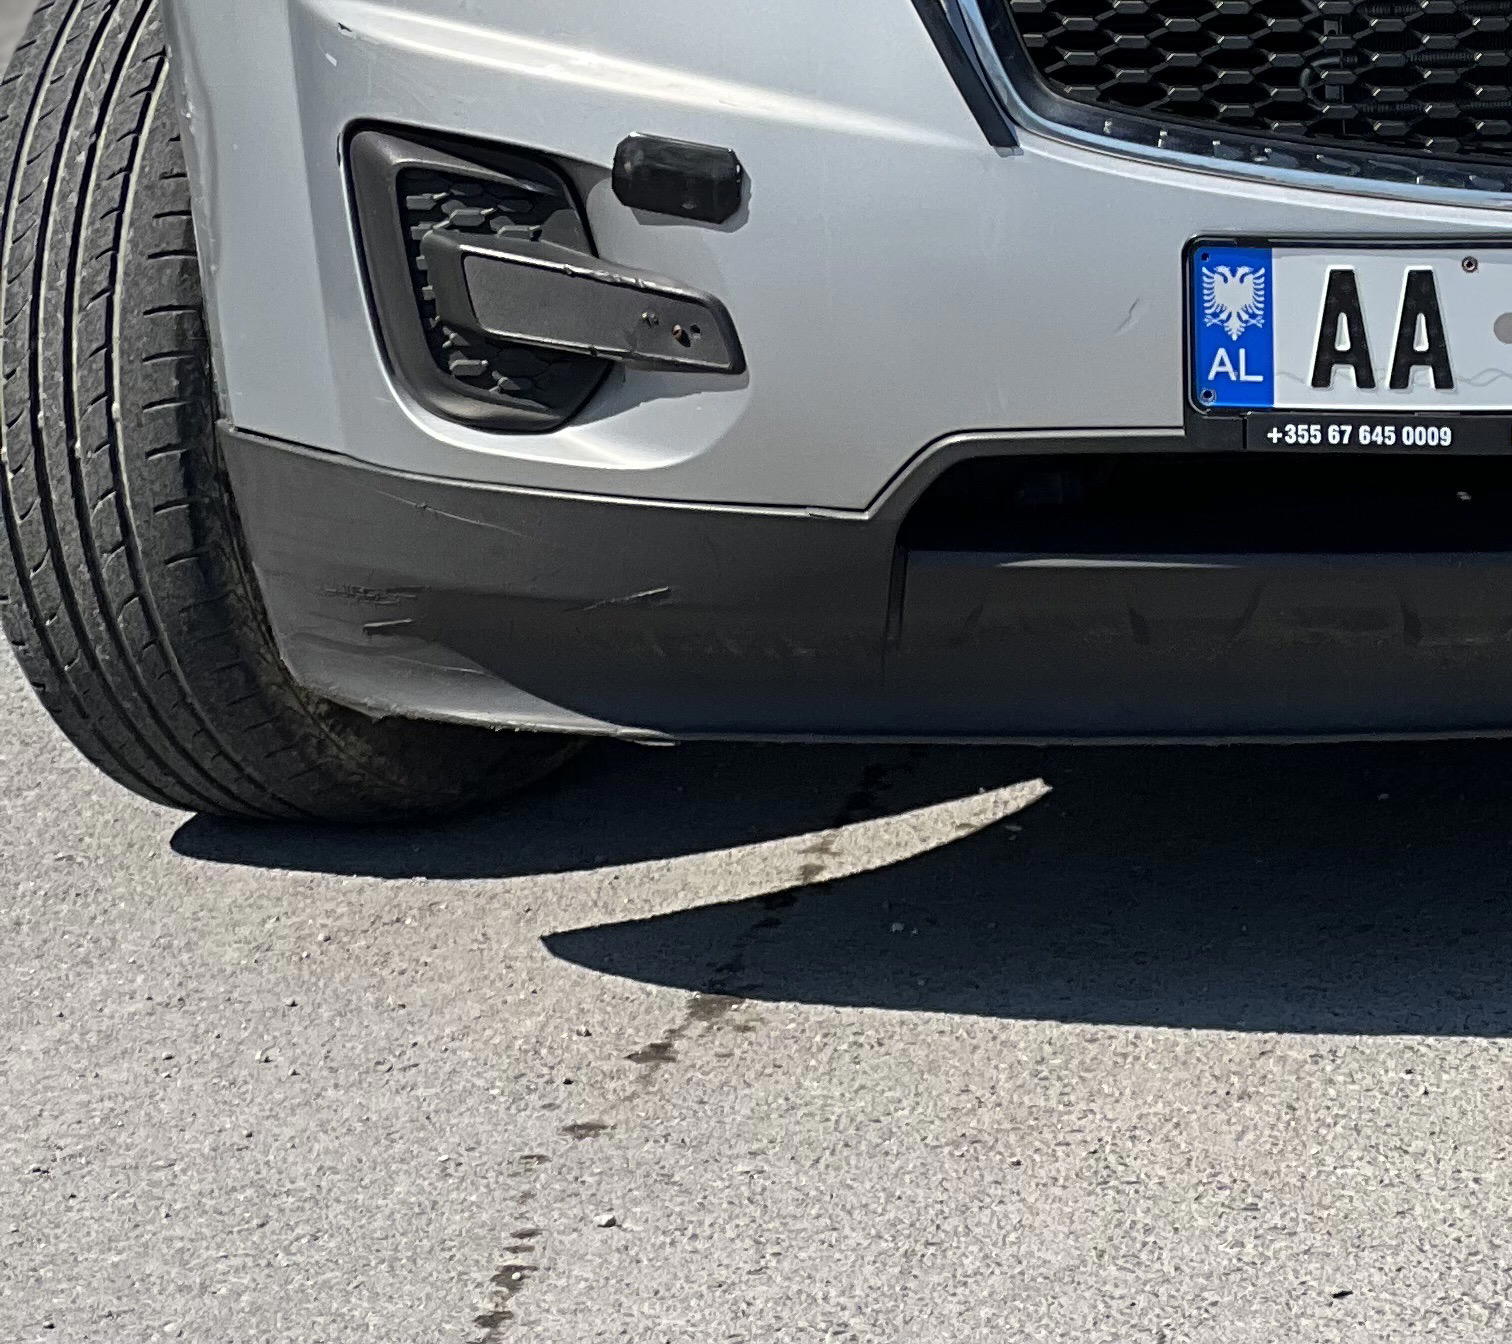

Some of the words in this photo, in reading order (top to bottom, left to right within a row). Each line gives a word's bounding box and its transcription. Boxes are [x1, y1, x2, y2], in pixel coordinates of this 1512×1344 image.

[1310, 267, 1455, 390] AA
[1207, 347, 1264, 382] AL
[1266, 423, 1322, 445] +355
[1327, 424, 1353, 445] 67
[1358, 425, 1396, 446] 645
[1401, 426, 1452, 447] 0009
